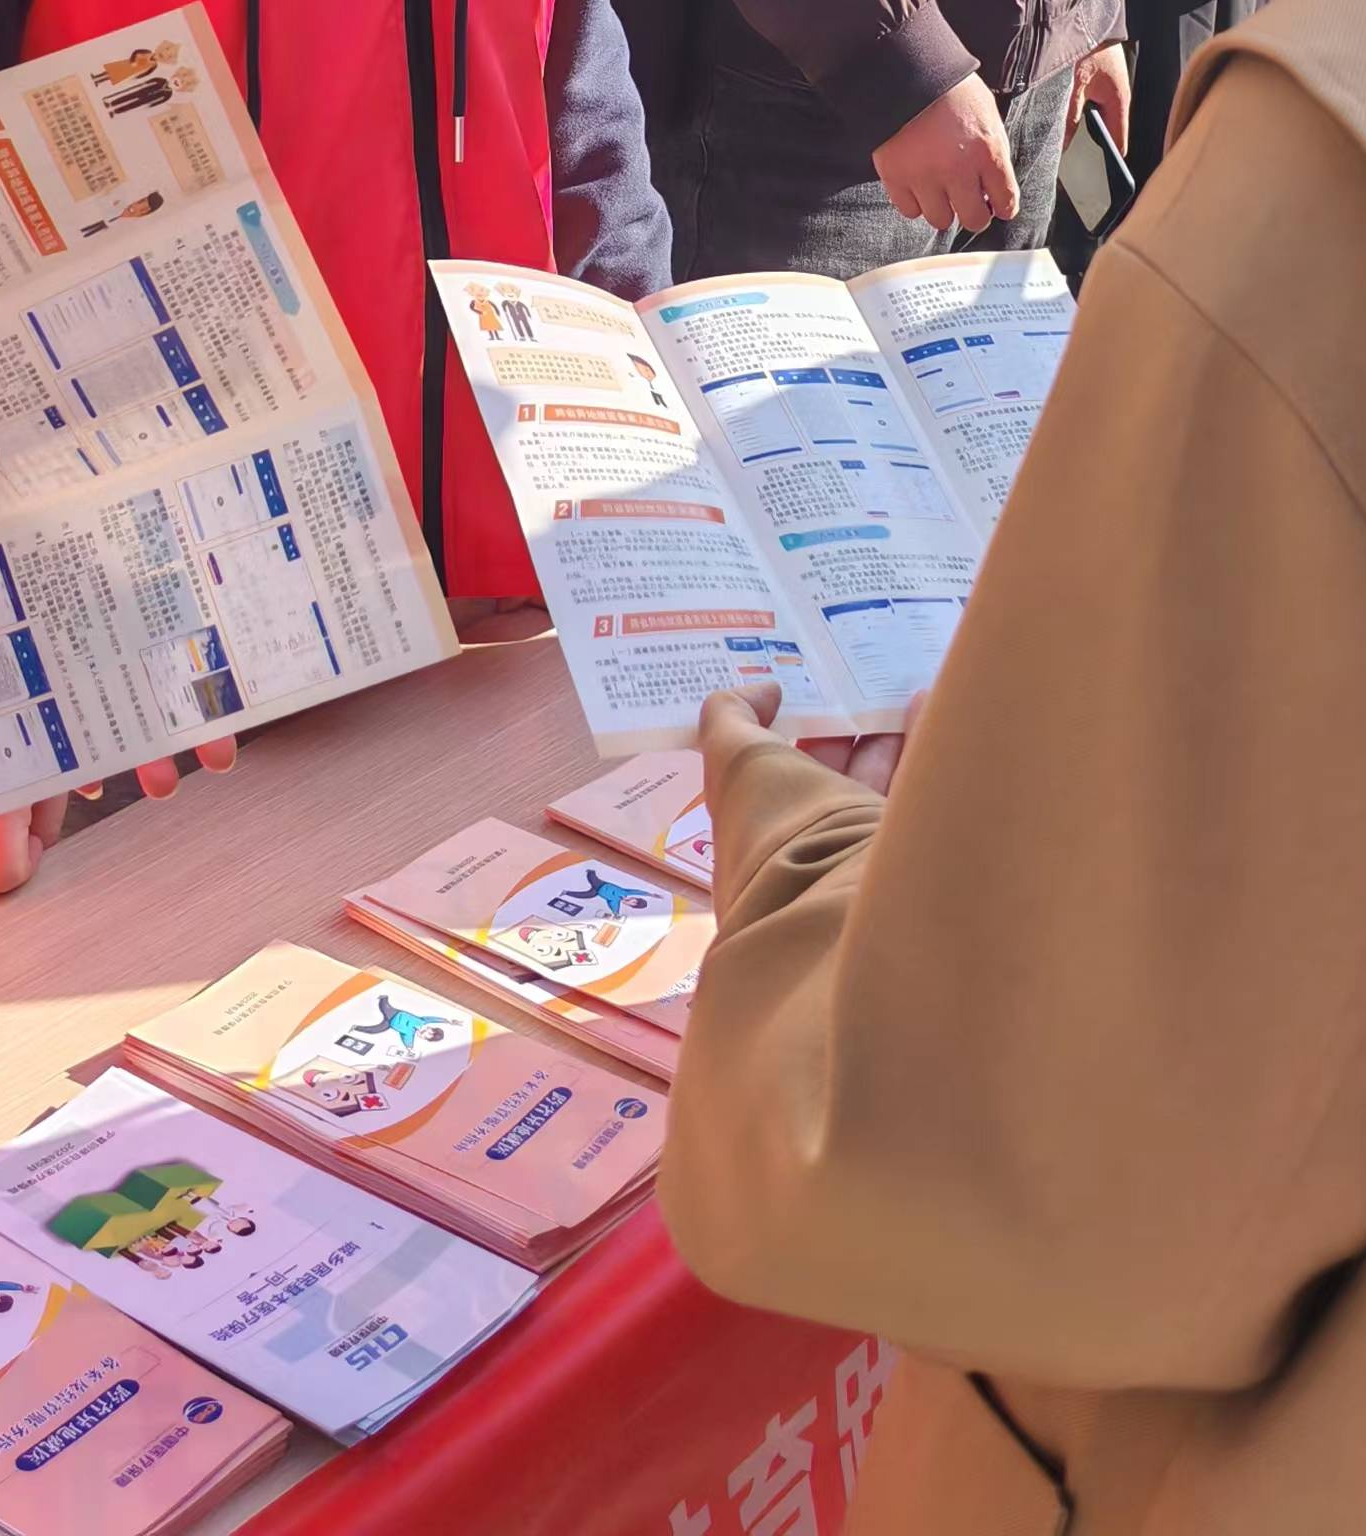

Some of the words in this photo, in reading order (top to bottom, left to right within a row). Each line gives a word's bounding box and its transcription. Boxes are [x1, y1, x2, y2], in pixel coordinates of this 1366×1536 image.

[558, 502, 568, 516] 2
[598, 619, 608, 633] 3
[206, 1237, 362, 1348] 城乡居民基本医疗保险
[234, 1257, 301, 1309] 一问一答
[342, 1320, 410, 1373] CHS
[20, 1382, 134, 1470] 跨省异地就医
[110, 1421, 193, 1491] 中国医疗保障
